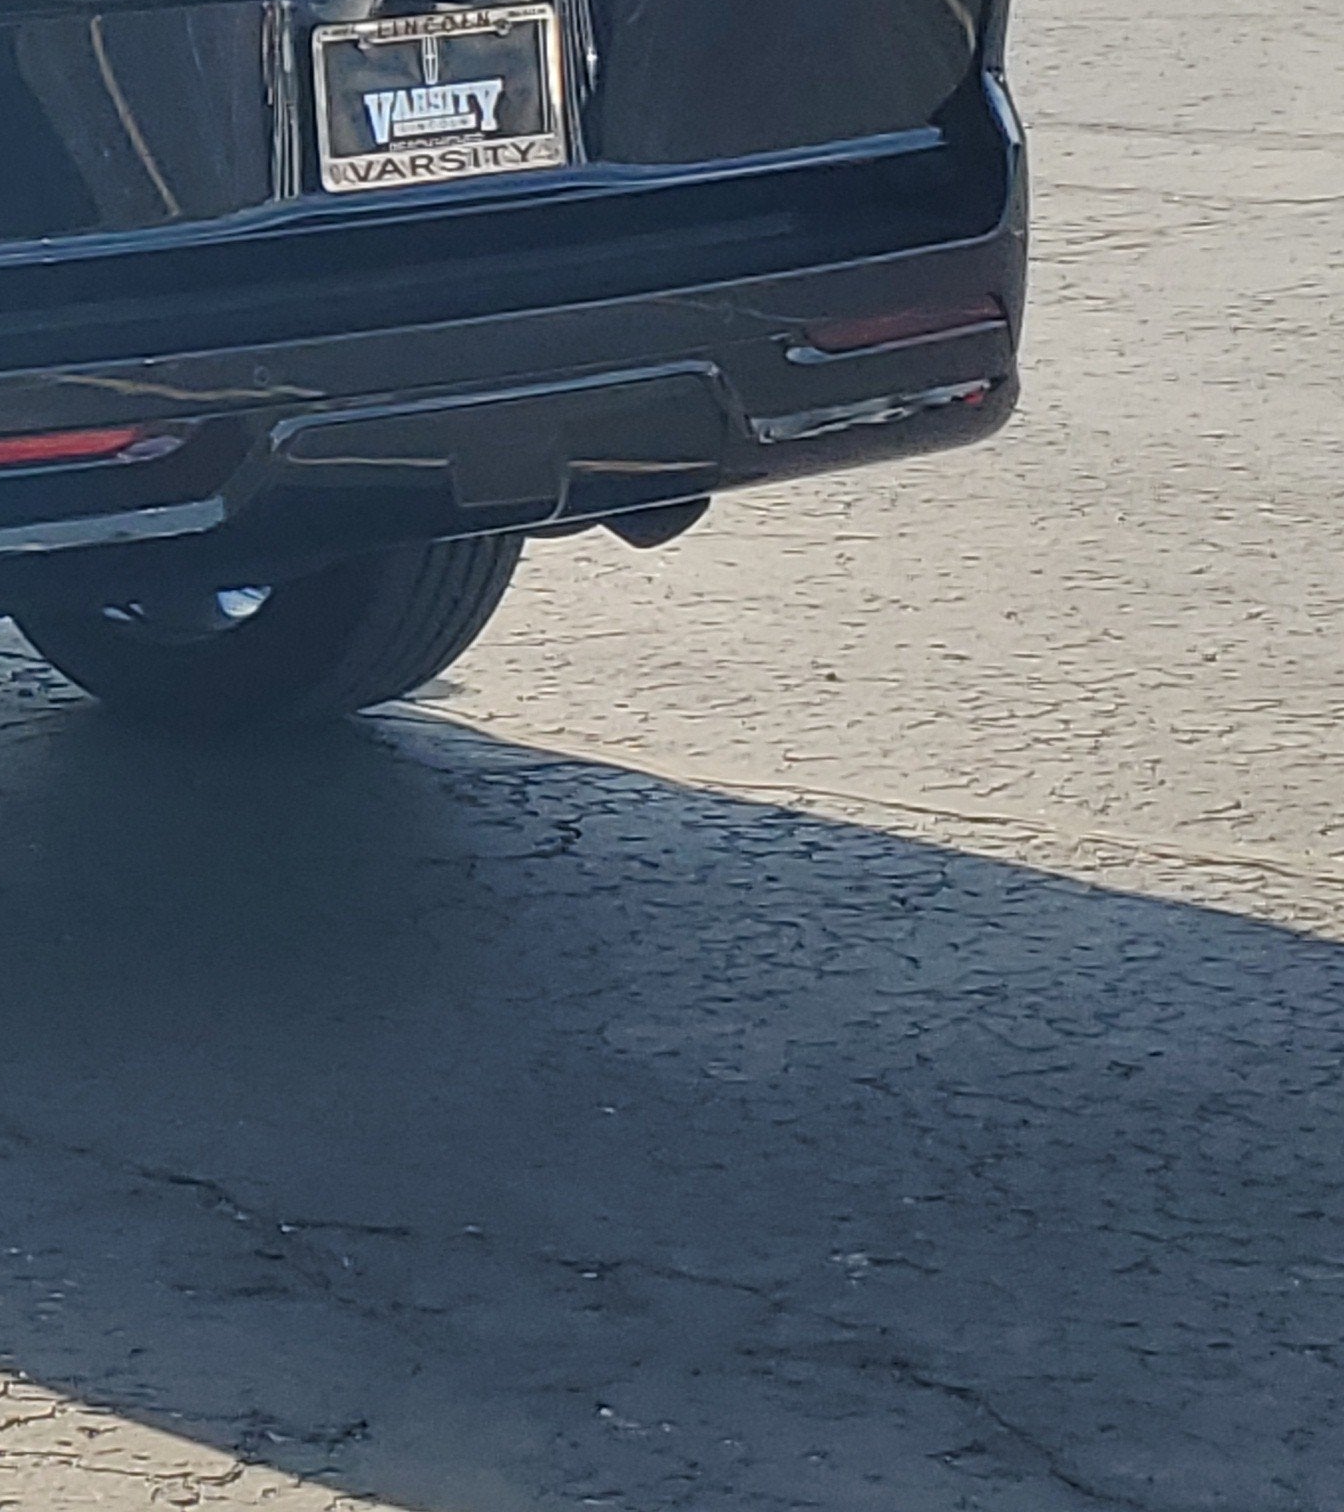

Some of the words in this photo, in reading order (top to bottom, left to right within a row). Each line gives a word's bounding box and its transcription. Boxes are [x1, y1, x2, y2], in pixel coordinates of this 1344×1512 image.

[377, 11, 491, 38] LINCOLN
[363, 78, 503, 145] VARSITY
[349, 141, 536, 183] VARSITY
